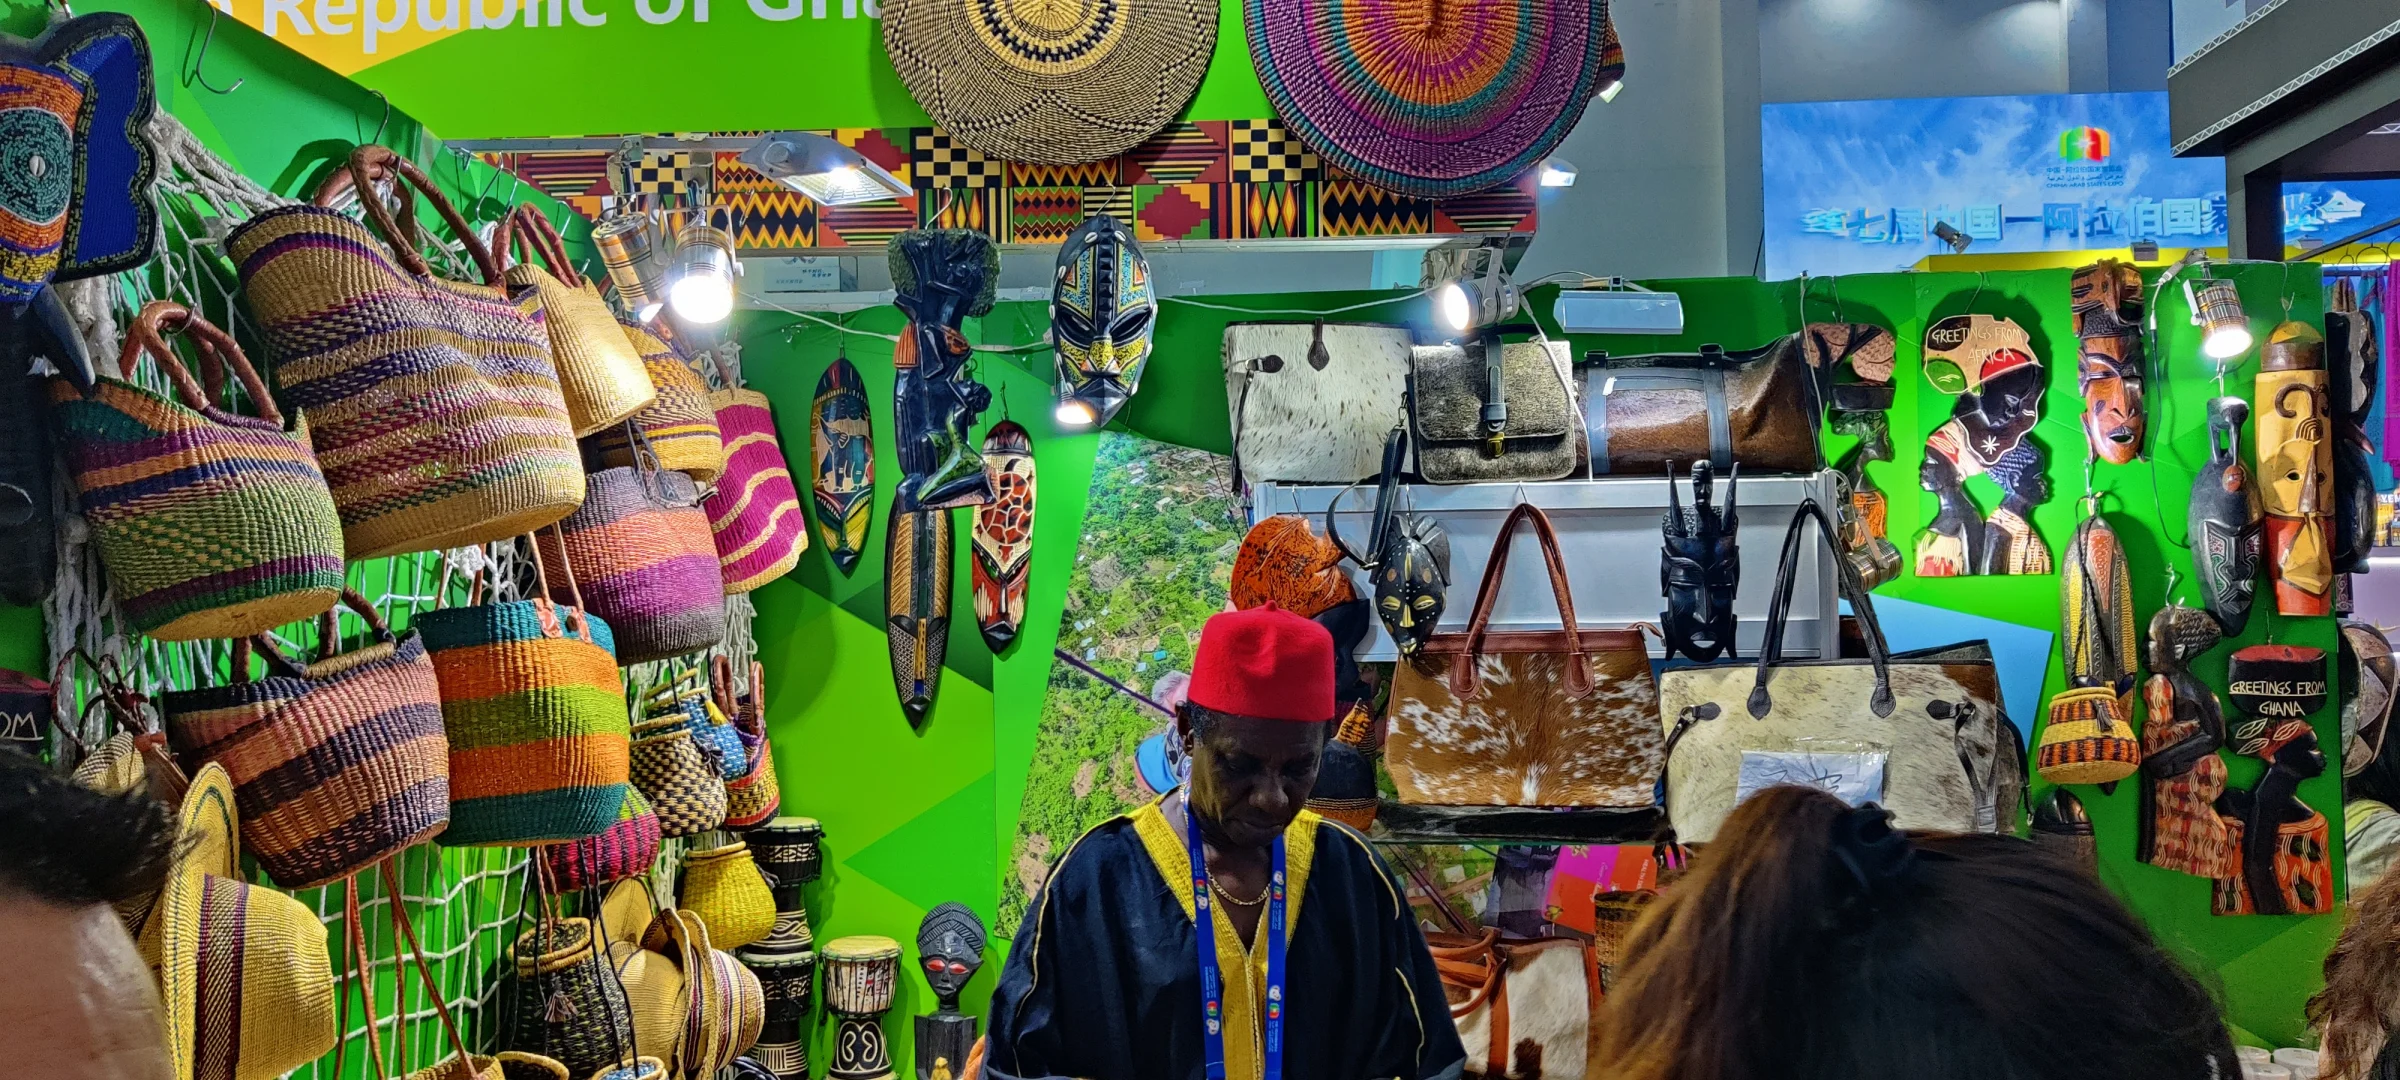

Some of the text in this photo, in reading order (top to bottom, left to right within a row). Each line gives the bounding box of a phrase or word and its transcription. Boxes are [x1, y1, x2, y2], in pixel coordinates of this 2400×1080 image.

[1931, 326, 2023, 344] GREETINGS FROM
[1967, 345, 2015, 365] AFRICA
[2229, 680, 2327, 696] GREETINGS FROM
[2258, 700, 2306, 717] GHANA
